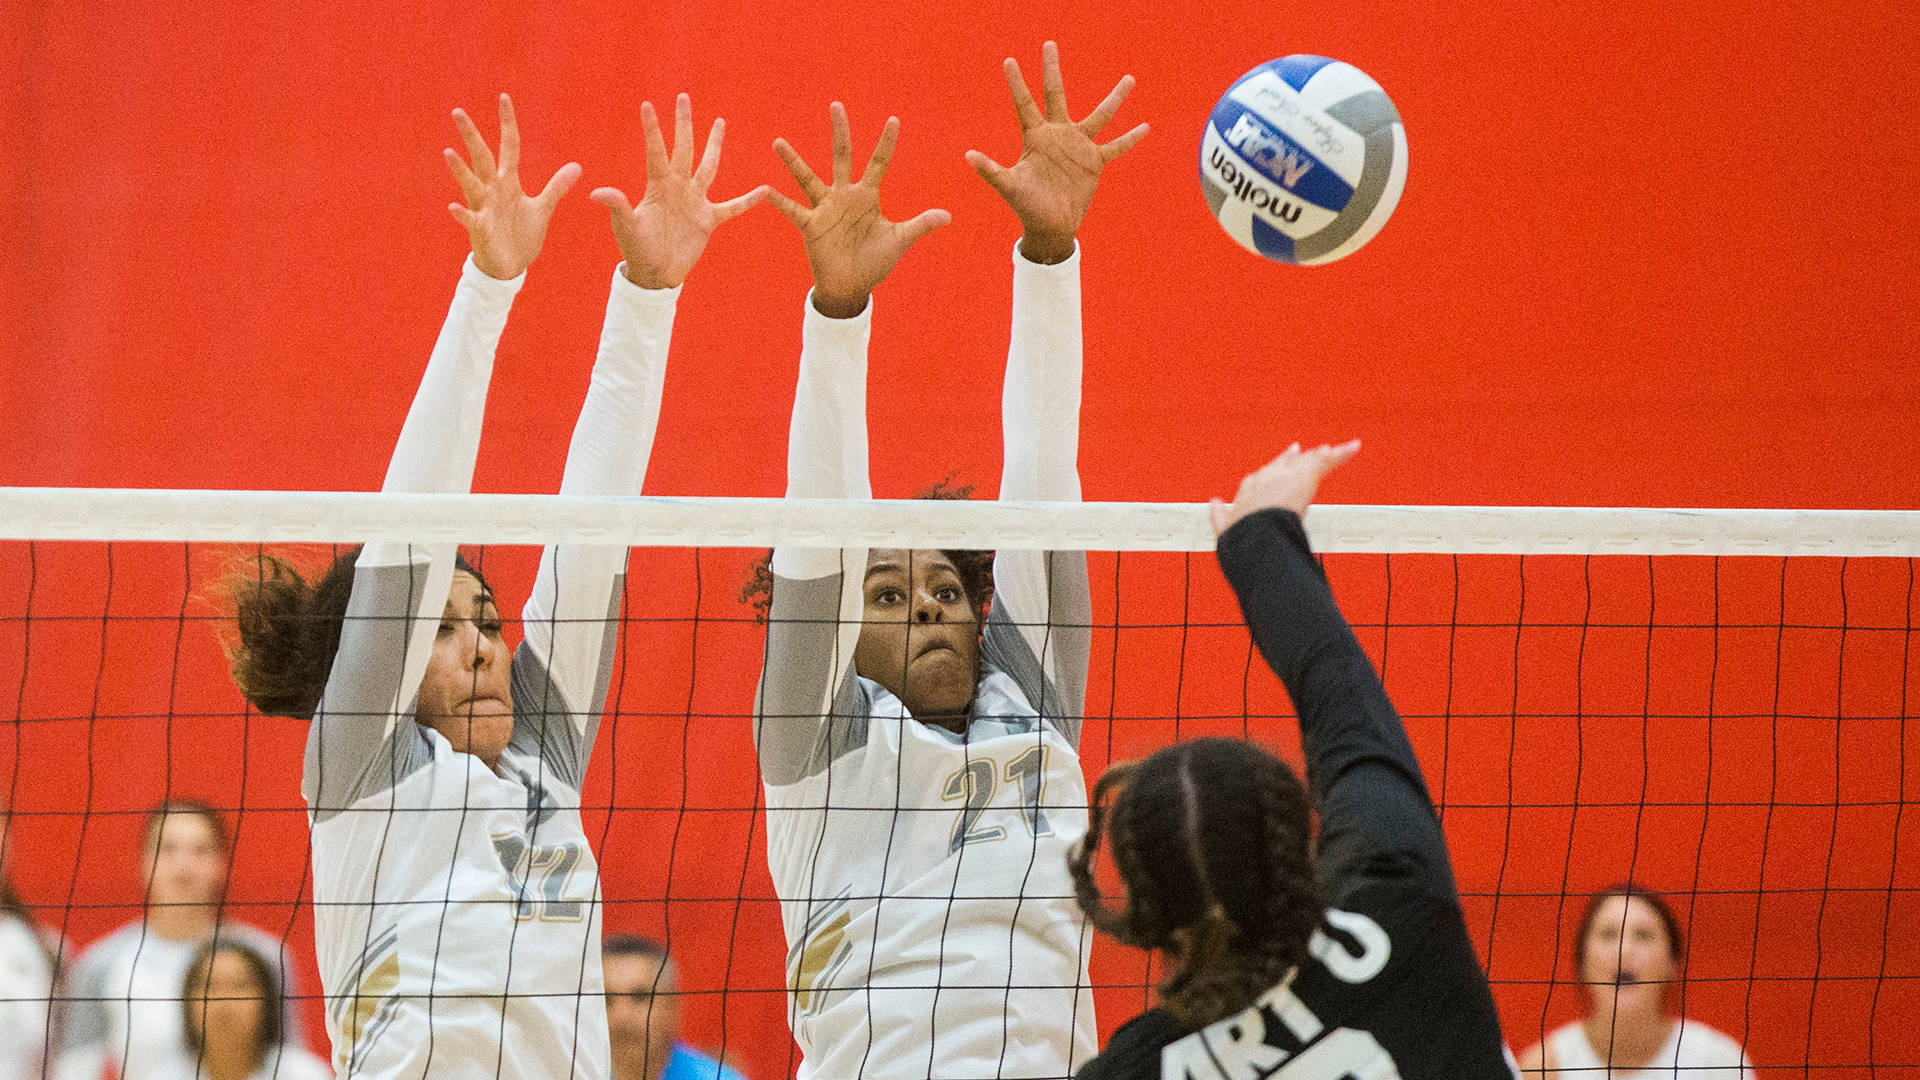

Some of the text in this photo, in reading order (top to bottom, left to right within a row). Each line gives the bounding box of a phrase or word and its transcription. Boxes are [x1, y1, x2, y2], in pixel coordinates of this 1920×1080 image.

[1211, 147, 1304, 224] molten
[1225, 112, 1315, 188] NCAA
[941, 744, 1056, 858] 21
[490, 831, 585, 922] 12
